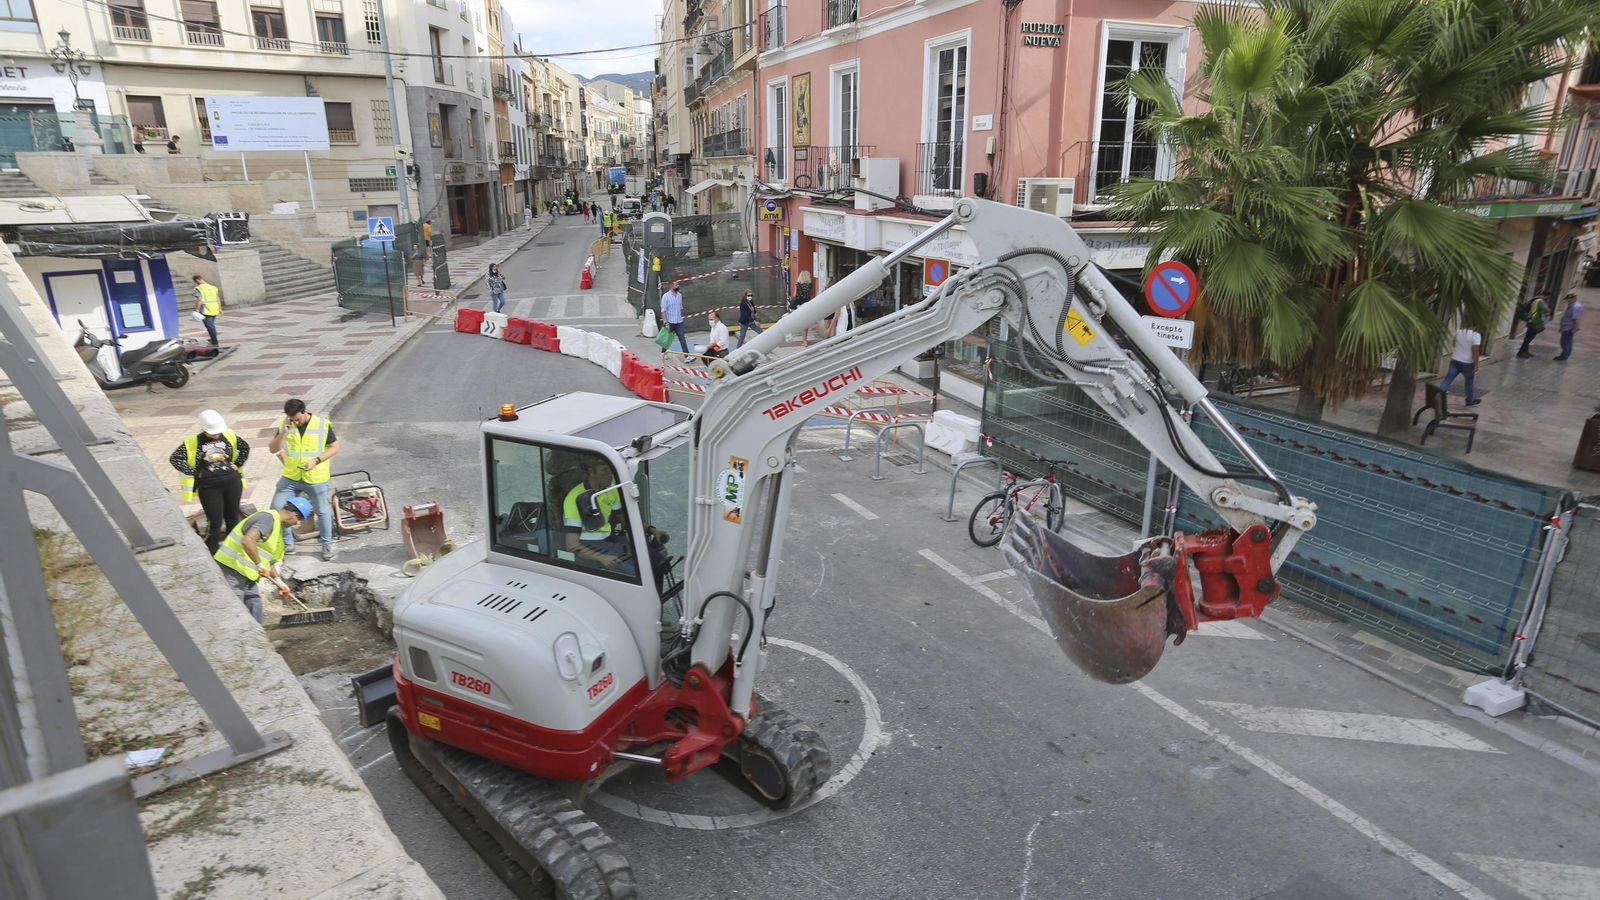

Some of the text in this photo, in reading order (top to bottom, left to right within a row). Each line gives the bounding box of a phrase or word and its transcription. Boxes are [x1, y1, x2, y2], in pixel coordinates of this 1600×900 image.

[1021, 22, 1064, 34] PUERTA
[1024, 35, 1061, 47] NUEVA
[0, 66, 28, 78] ET
[1151, 322, 1183, 333] Excepto
[1155, 331, 1184, 341] tinetes
[451, 671, 491, 695] TB260
[587, 672, 613, 700] TB260
